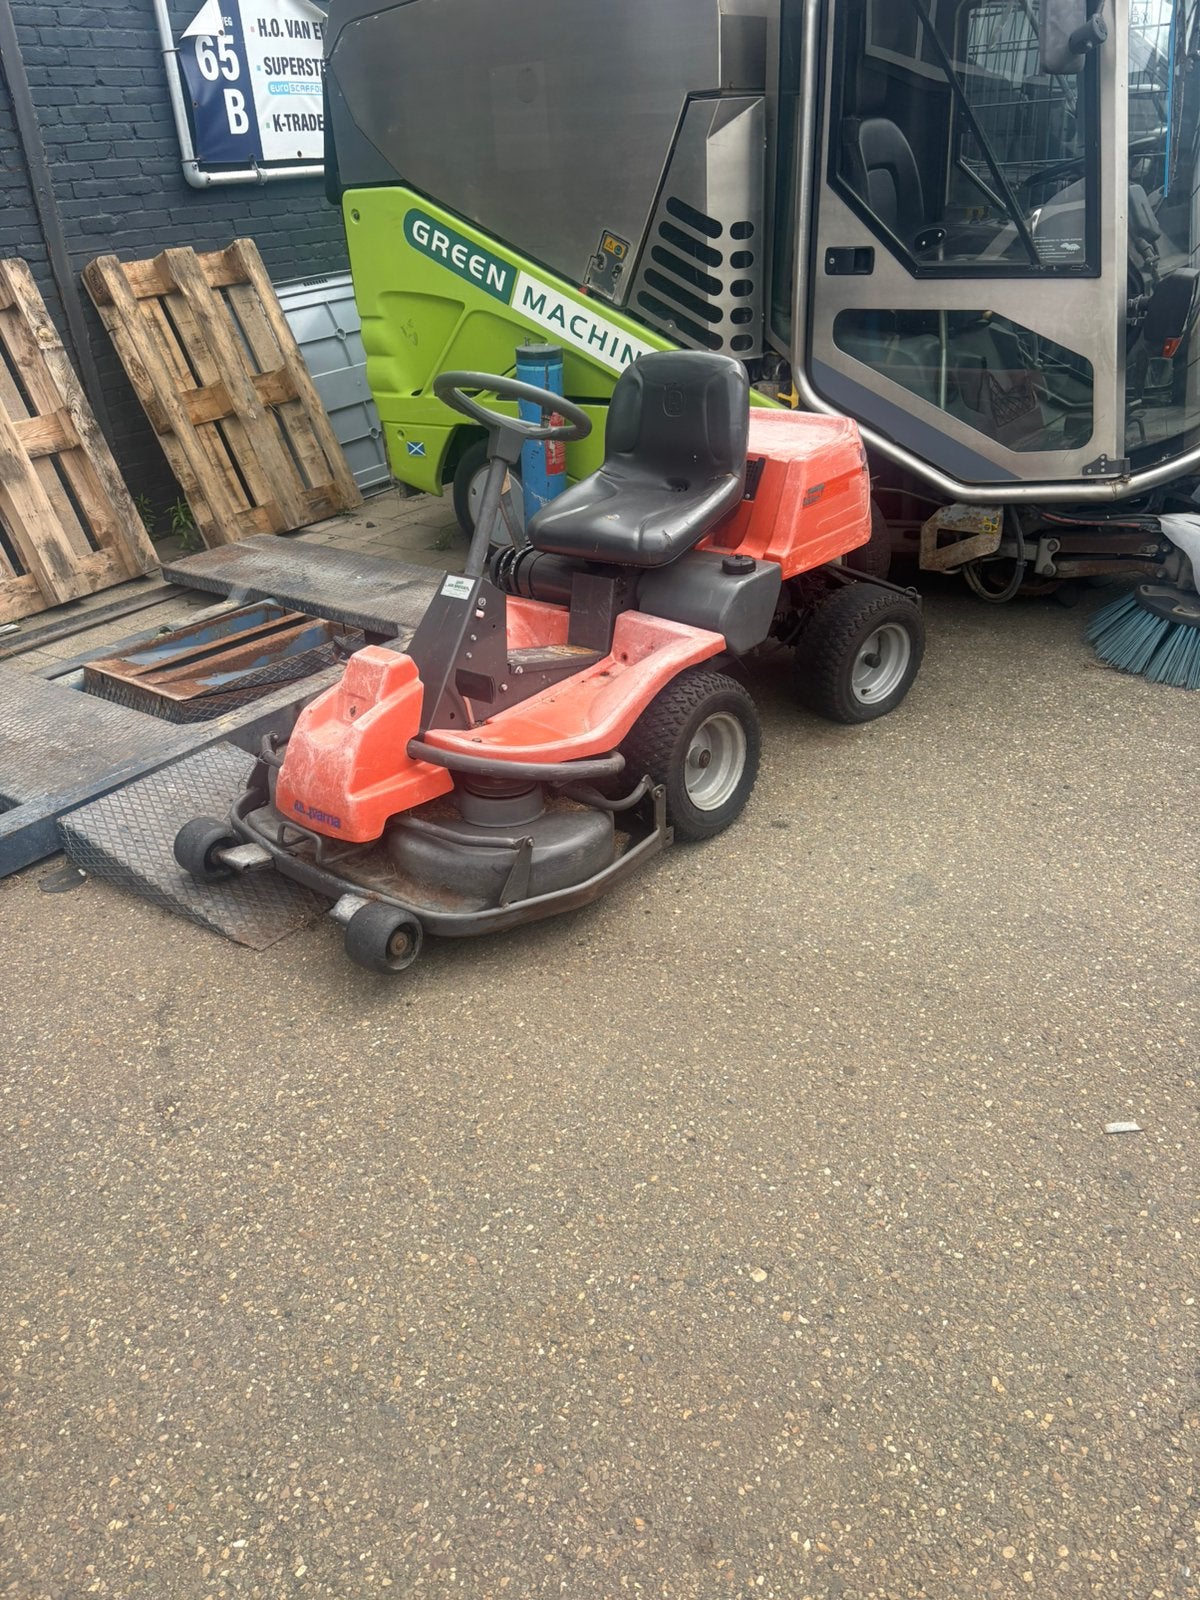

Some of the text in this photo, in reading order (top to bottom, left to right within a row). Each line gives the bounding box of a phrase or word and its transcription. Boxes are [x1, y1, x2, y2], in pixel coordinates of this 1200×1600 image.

[257, 18, 285, 37] H.O.
[284, 19, 312, 40] VAN
[195, 34, 241, 81] 65
[223, 88, 250, 135] B
[272, 113, 324, 132] K-TRADE
[411, 219, 507, 293] GREEN
